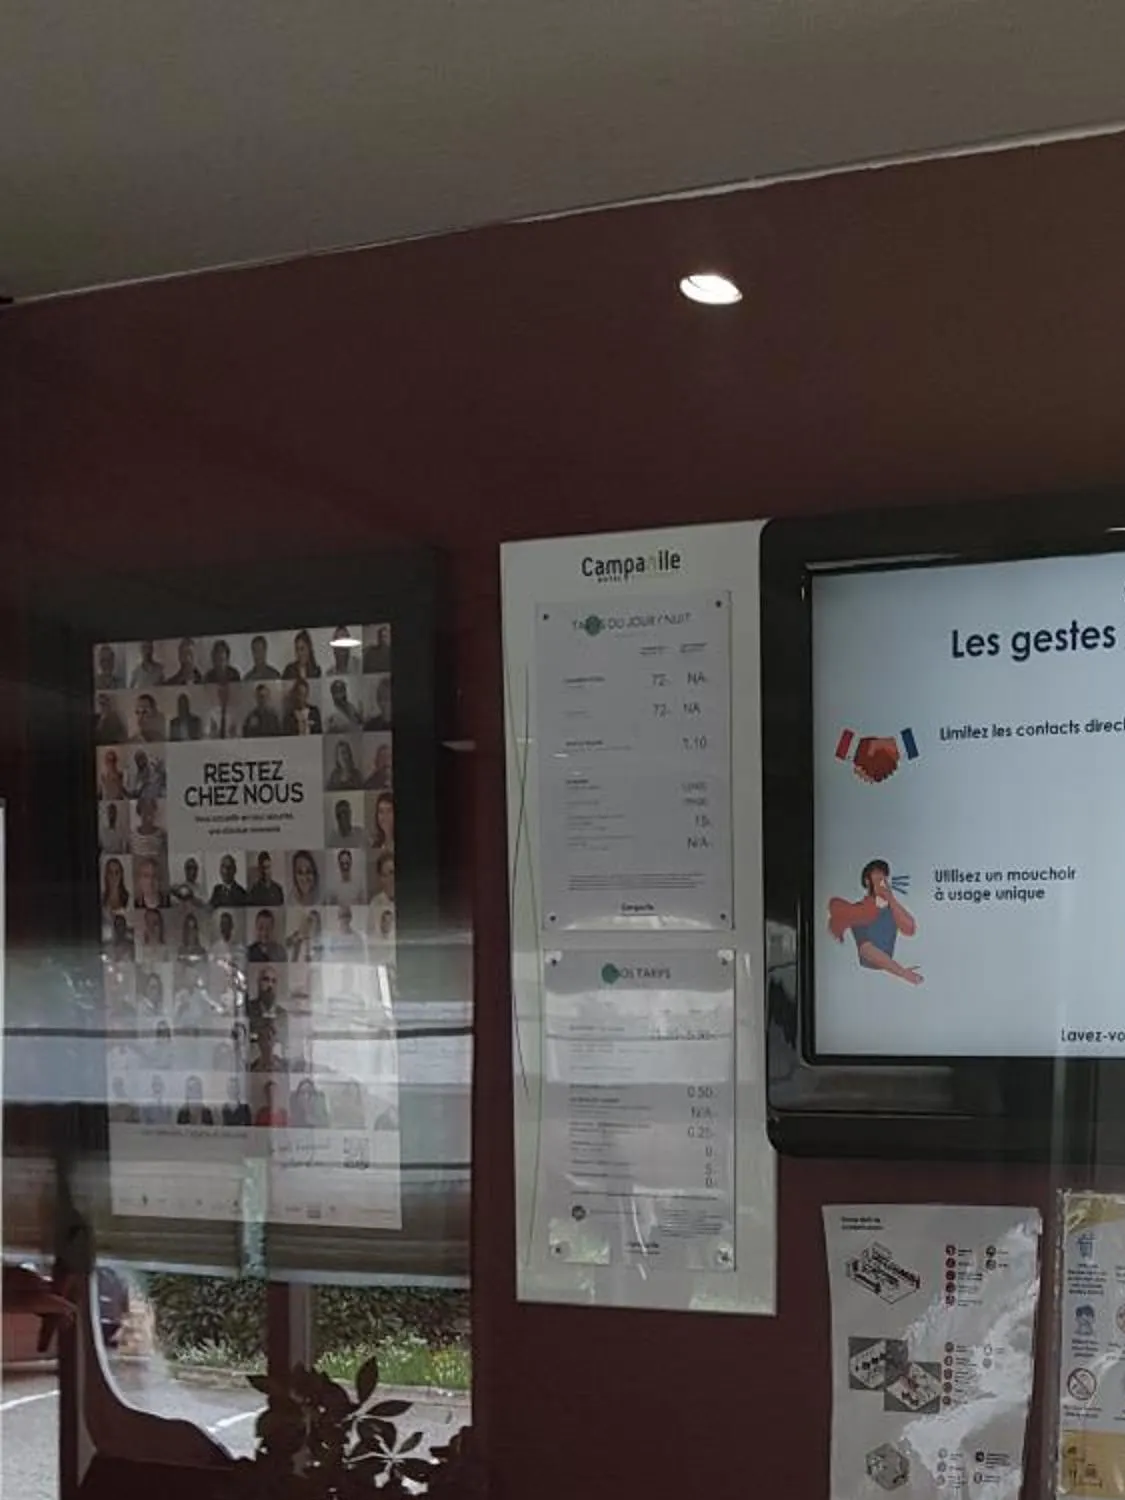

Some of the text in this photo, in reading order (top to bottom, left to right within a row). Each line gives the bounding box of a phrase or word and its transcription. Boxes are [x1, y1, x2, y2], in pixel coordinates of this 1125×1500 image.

[581, 549, 681, 580] Campaile
[951, 629, 999, 658] Les
[1011, 619, 1116, 662] gestes
[940, 725, 988, 741] Limitez
[991, 723, 1012, 738] les
[1015, 719, 1081, 737] contacts
[203, 760, 284, 784] RESTEZ
[184, 782, 304, 808] CHEZ NOUS
[934, 866, 1076, 883] Utilisez un mouchoir
[934, 885, 1046, 904] à usage unique
